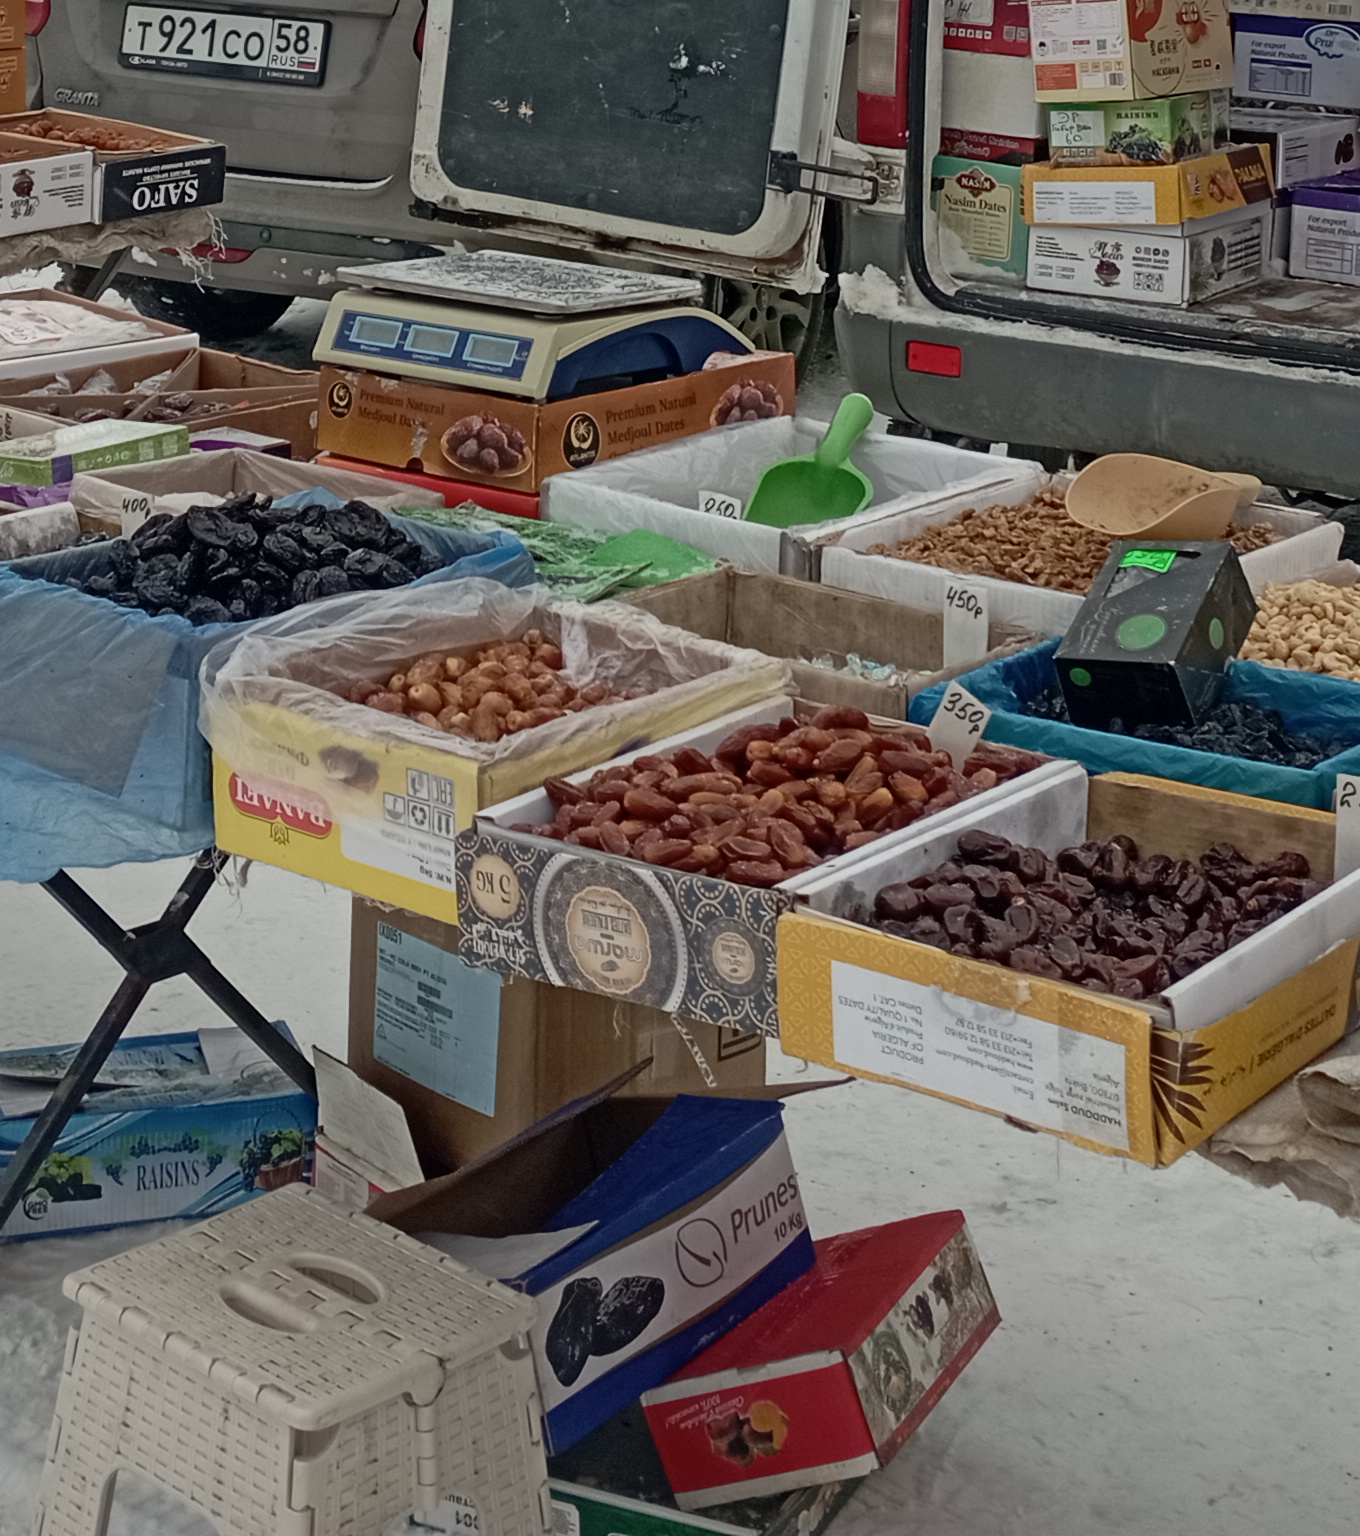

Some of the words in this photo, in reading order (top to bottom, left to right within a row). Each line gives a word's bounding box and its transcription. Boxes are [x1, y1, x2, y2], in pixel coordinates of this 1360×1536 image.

[275, 22, 310, 55] 58
[1264, 42, 1286, 51] export
[270, 54, 297, 67] RUS
[1250, 48, 1277, 57] Natural
[1277, 51, 1308, 60] Products
[55, 88, 99, 106] GRANTA
[1115, 111, 1159, 120] RAISINS
[960, 176, 990, 190] NASIM
[132, 178, 199, 211] SAFO
[944, 193, 978, 209] Nasim
[978, 198, 1008, 214] Dates
[1307, 215, 1321, 224] For
[1322, 217, 1347, 228] export
[1307, 225, 1337, 235] Natural
[359, 389, 404, 408] Premium
[406, 397, 445, 415] Natural
[605, 402, 656, 424] Premium
[659, 391, 697, 412] Natural
[357, 406, 397, 425] Medjoul
[607, 426, 652, 446] Medjoul
[656, 418, 685, 435] Dates
[946, 585, 983, 620] 450р
[943, 692, 985, 735] 350р
[475, 870, 494, 891] KG
[498, 874, 513, 905] 5
[574, 935, 643, 963] marwa
[837, 994, 865, 1012] DATES
[878, 994, 897, 1009] CAT.
[898, 1000, 922, 1016] Dattes
[865, 1004, 904, 1023] QUALITY
[910, 1016, 923, 1028] No.
[1301, 1004, 1337, 1035] DATTES
[898, 1023, 924, 1040] Produit
[965, 1022, 975, 1034] 12
[975, 1025, 987, 1038] 58
[987, 1029, 1000, 1041] 33
[871, 1029, 910, 1048] ALGERIA
[910, 1041, 925, 1052] OF
[964, 1034, 976, 1046] 12
[977, 1037, 988, 1050] 58
[1256, 1026, 1303, 1068] D'ALGERIE
[880, 1044, 925, 1065] PRODUCT
[988, 1042, 1002, 1054] 33
[1092, 1071, 1120, 1089] Algeria
[1046, 1096, 1070, 1113] Salim
[1070, 1103, 1122, 1128] HADDOUD
[136, 1159, 200, 1192] RAISINS
[730, 1173, 798, 1245] Prunes
[774, 1223, 787, 1242] 10
[789, 1213, 803, 1231] Kg
